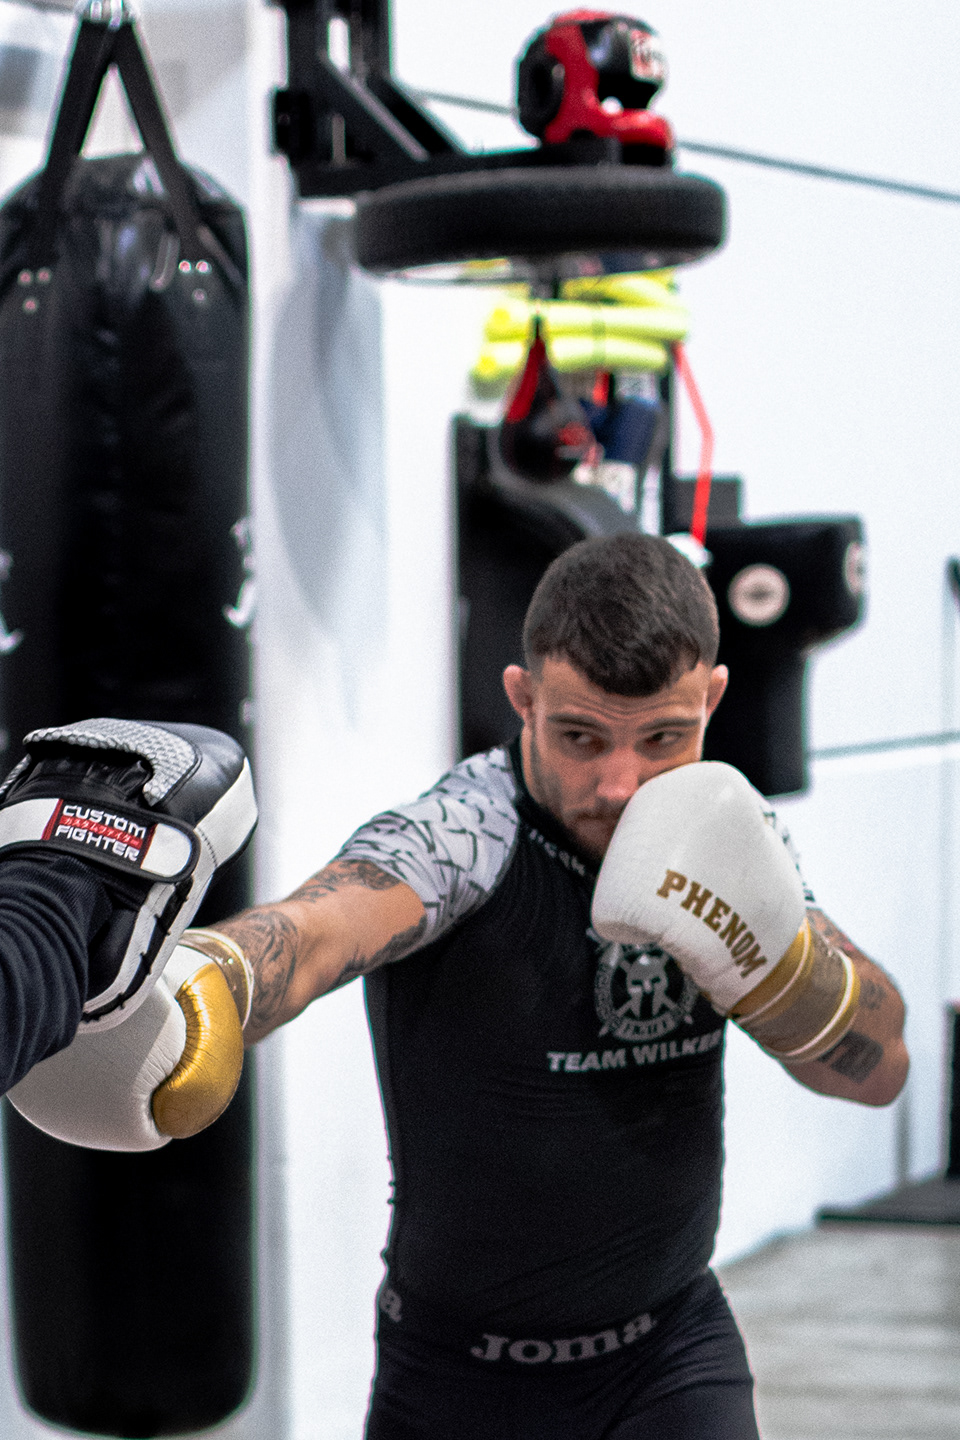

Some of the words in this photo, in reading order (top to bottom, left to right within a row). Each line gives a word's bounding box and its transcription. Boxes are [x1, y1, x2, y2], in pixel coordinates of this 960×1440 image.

[62, 805, 147, 839] CUSTOM
[54, 824, 140, 862] FIGHTER
[656, 868, 768, 979] PHENOM
[546, 1048, 626, 1073] TEAM
